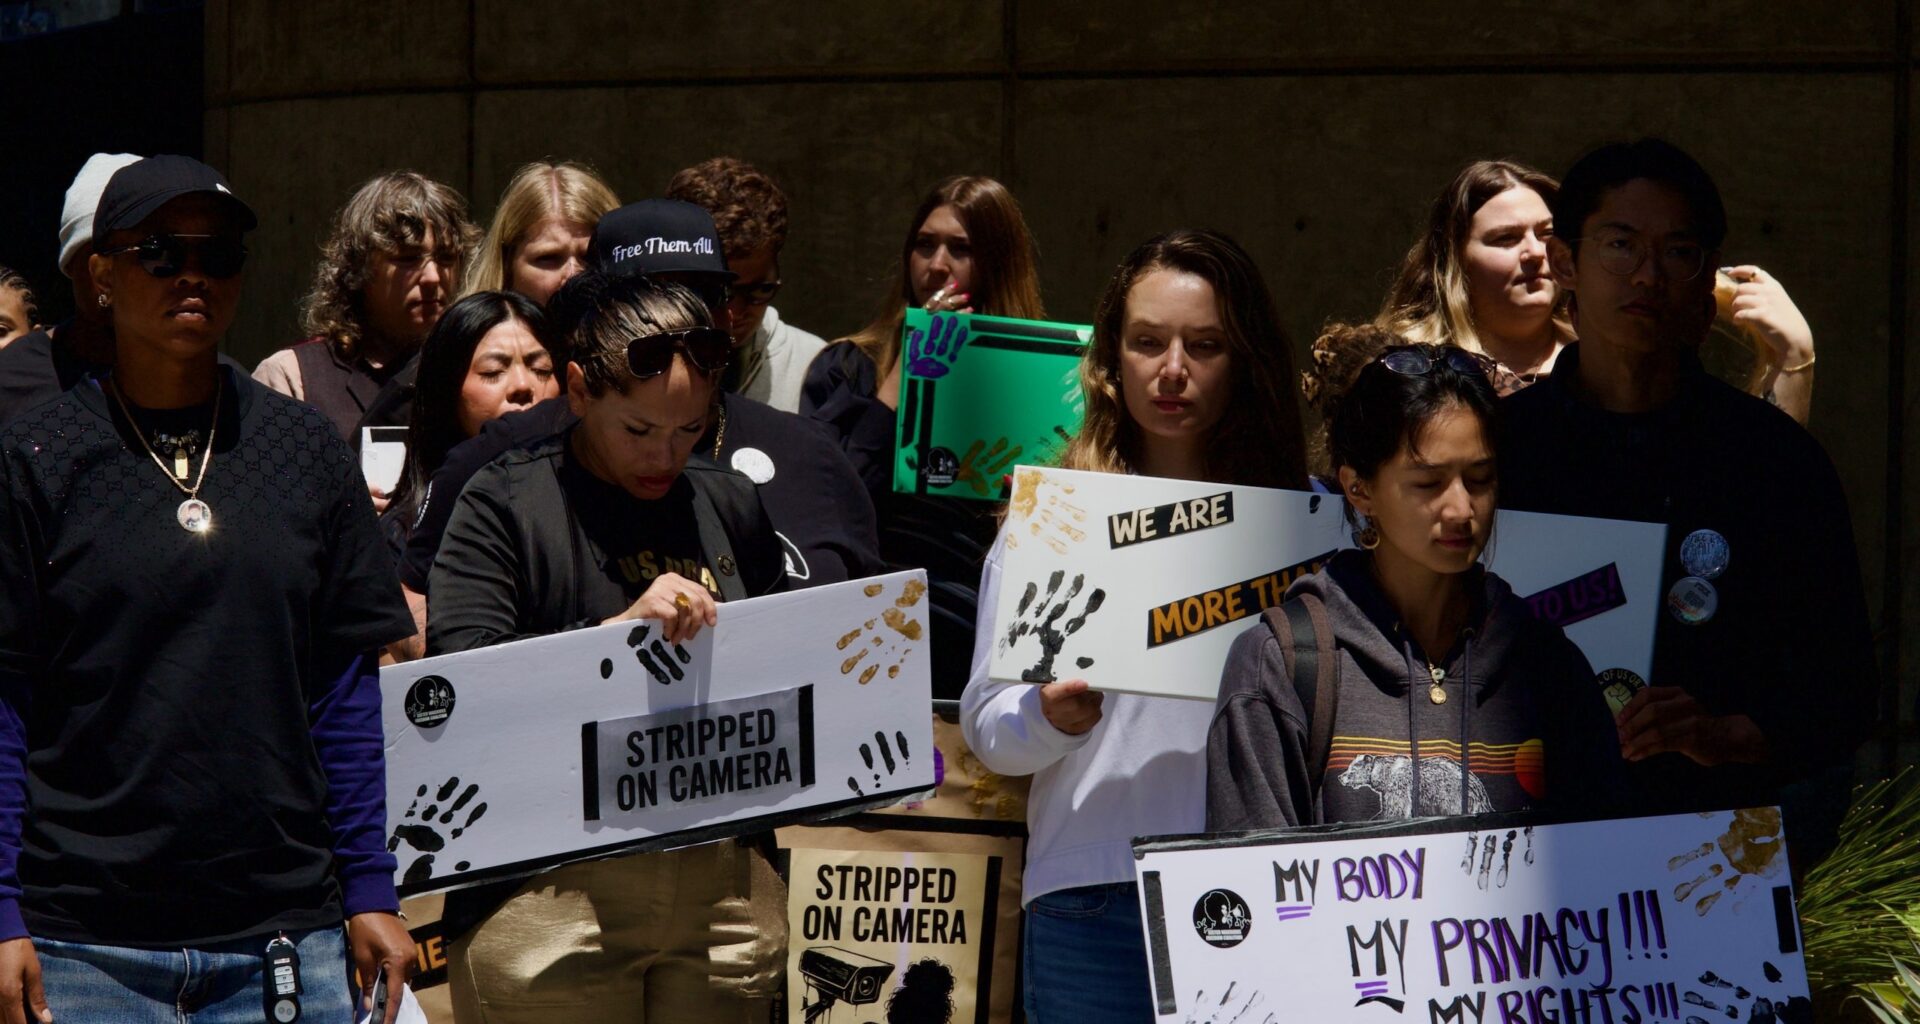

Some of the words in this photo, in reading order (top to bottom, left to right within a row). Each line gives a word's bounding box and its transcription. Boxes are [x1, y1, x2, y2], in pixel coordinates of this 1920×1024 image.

[612, 243, 643, 263] Free
[645, 236, 692, 255] Them
[693, 236, 714, 255] All
[1111, 507, 1157, 544] WE
[1168, 494, 1229, 534] ARE
[617, 549, 660, 584] US
[1567, 566, 1618, 612] US!
[1152, 583, 1247, 645] MORE
[626, 708, 776, 768] STRIPPED
[616, 769, 658, 811] ON
[669, 747, 793, 802] CAMERA
[816, 864, 957, 904] STRIPPED
[1272, 858, 1320, 906] MY
[1333, 847, 1426, 902] BODY
[803, 905, 842, 941] ON
[852, 906, 967, 945] CAMERA
[1346, 917, 1409, 995] MY
[1428, 991, 1486, 1024] MY
